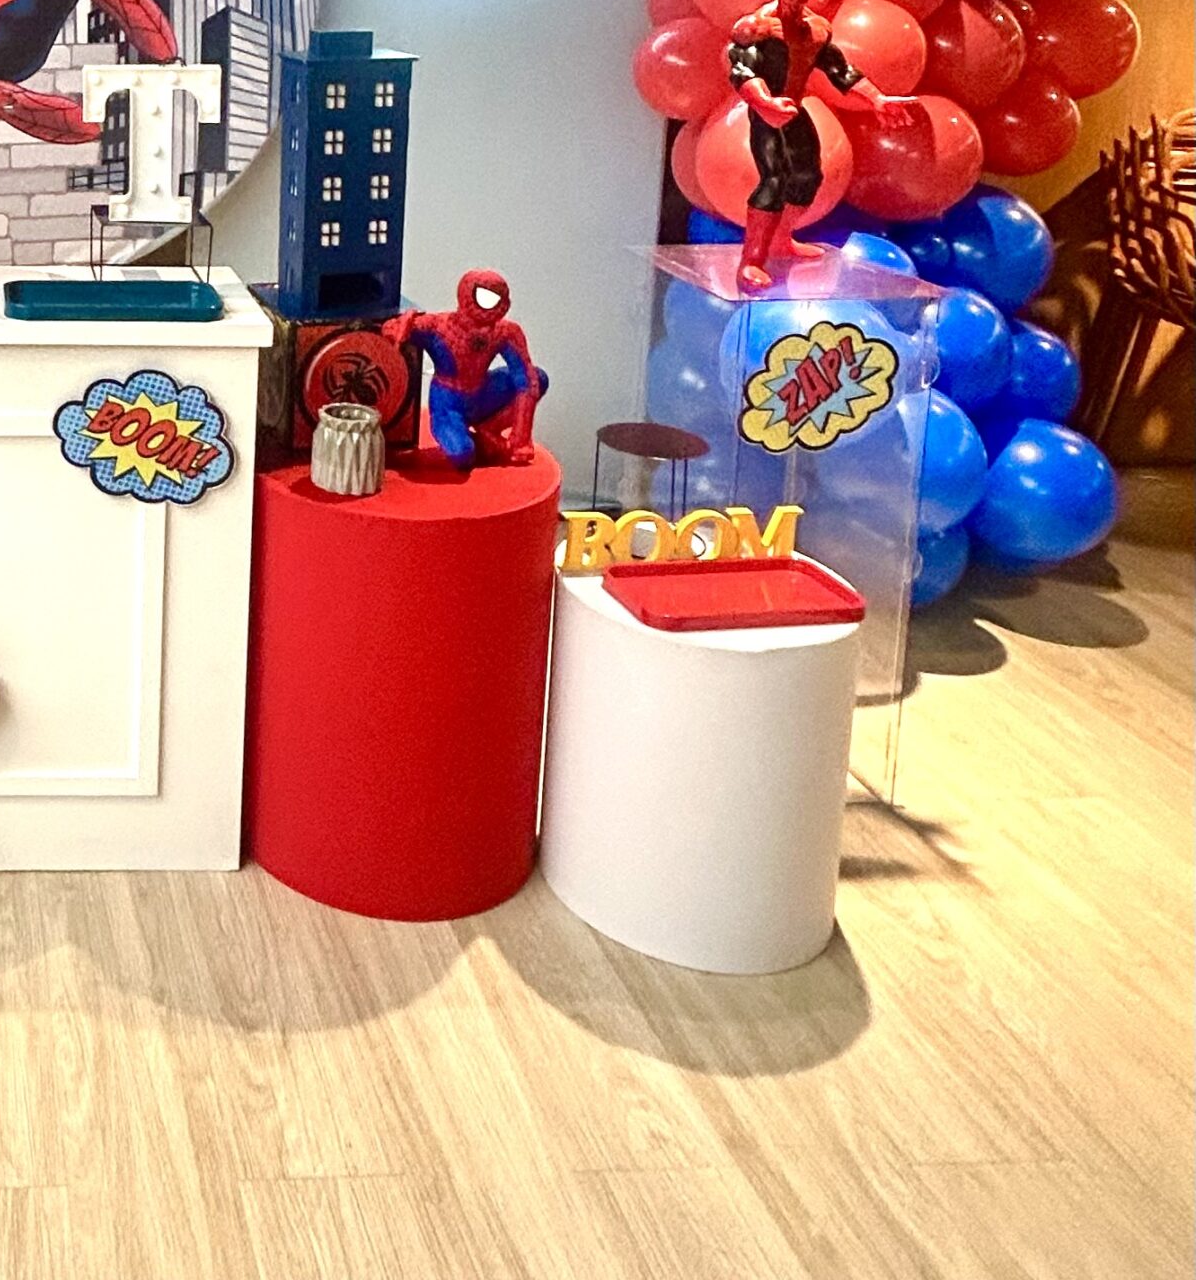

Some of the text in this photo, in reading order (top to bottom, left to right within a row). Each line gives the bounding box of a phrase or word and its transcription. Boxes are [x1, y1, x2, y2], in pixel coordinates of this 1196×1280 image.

[82, 64, 222, 223] T
[777, 336, 862, 426] ZAP!
[87, 400, 222, 479] BOOM!
[560, 506, 804, 577] BOOM
